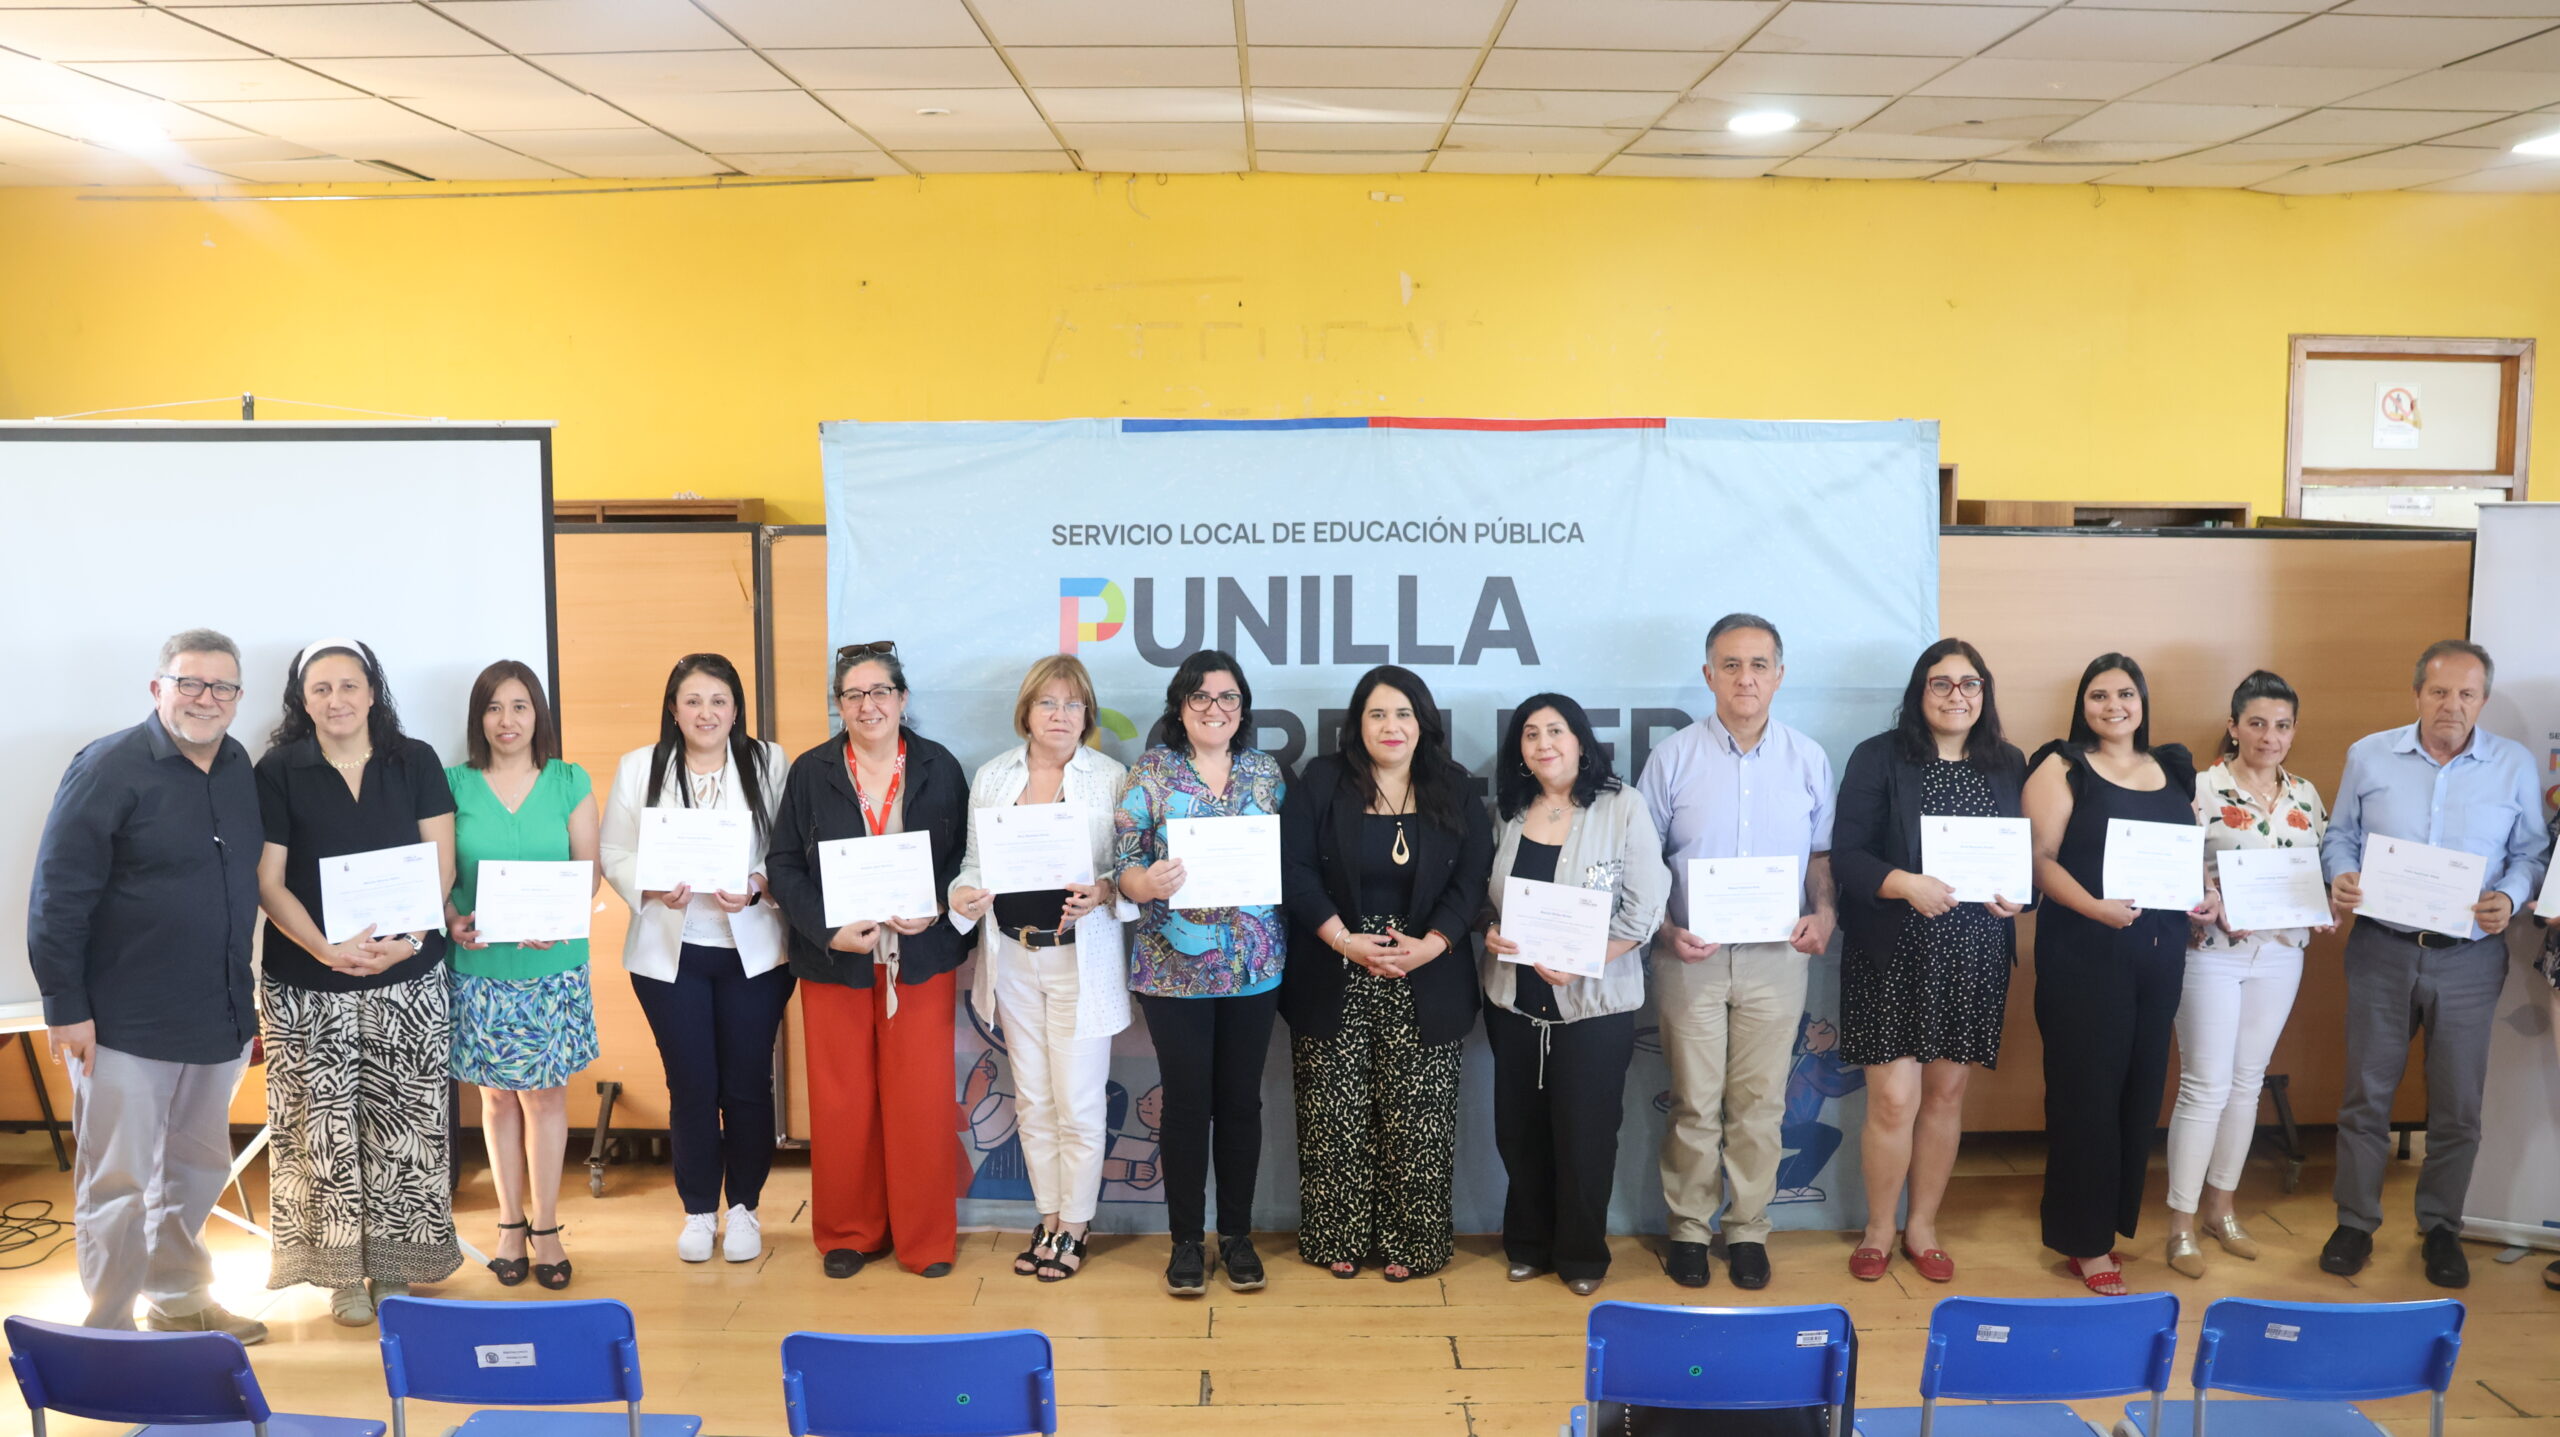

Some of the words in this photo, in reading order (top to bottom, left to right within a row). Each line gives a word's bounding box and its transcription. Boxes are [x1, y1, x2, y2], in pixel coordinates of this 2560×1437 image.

[1051, 523, 1173, 546] SERVICIO
[1180, 523, 1265, 545] LOCAL
[1272, 522, 1306, 544] DE
[1313, 516, 1467, 543] EDUCACIÓN
[1475, 516, 1585, 544] PÚBLICA
[1059, 575, 1541, 668] PUNILLA
